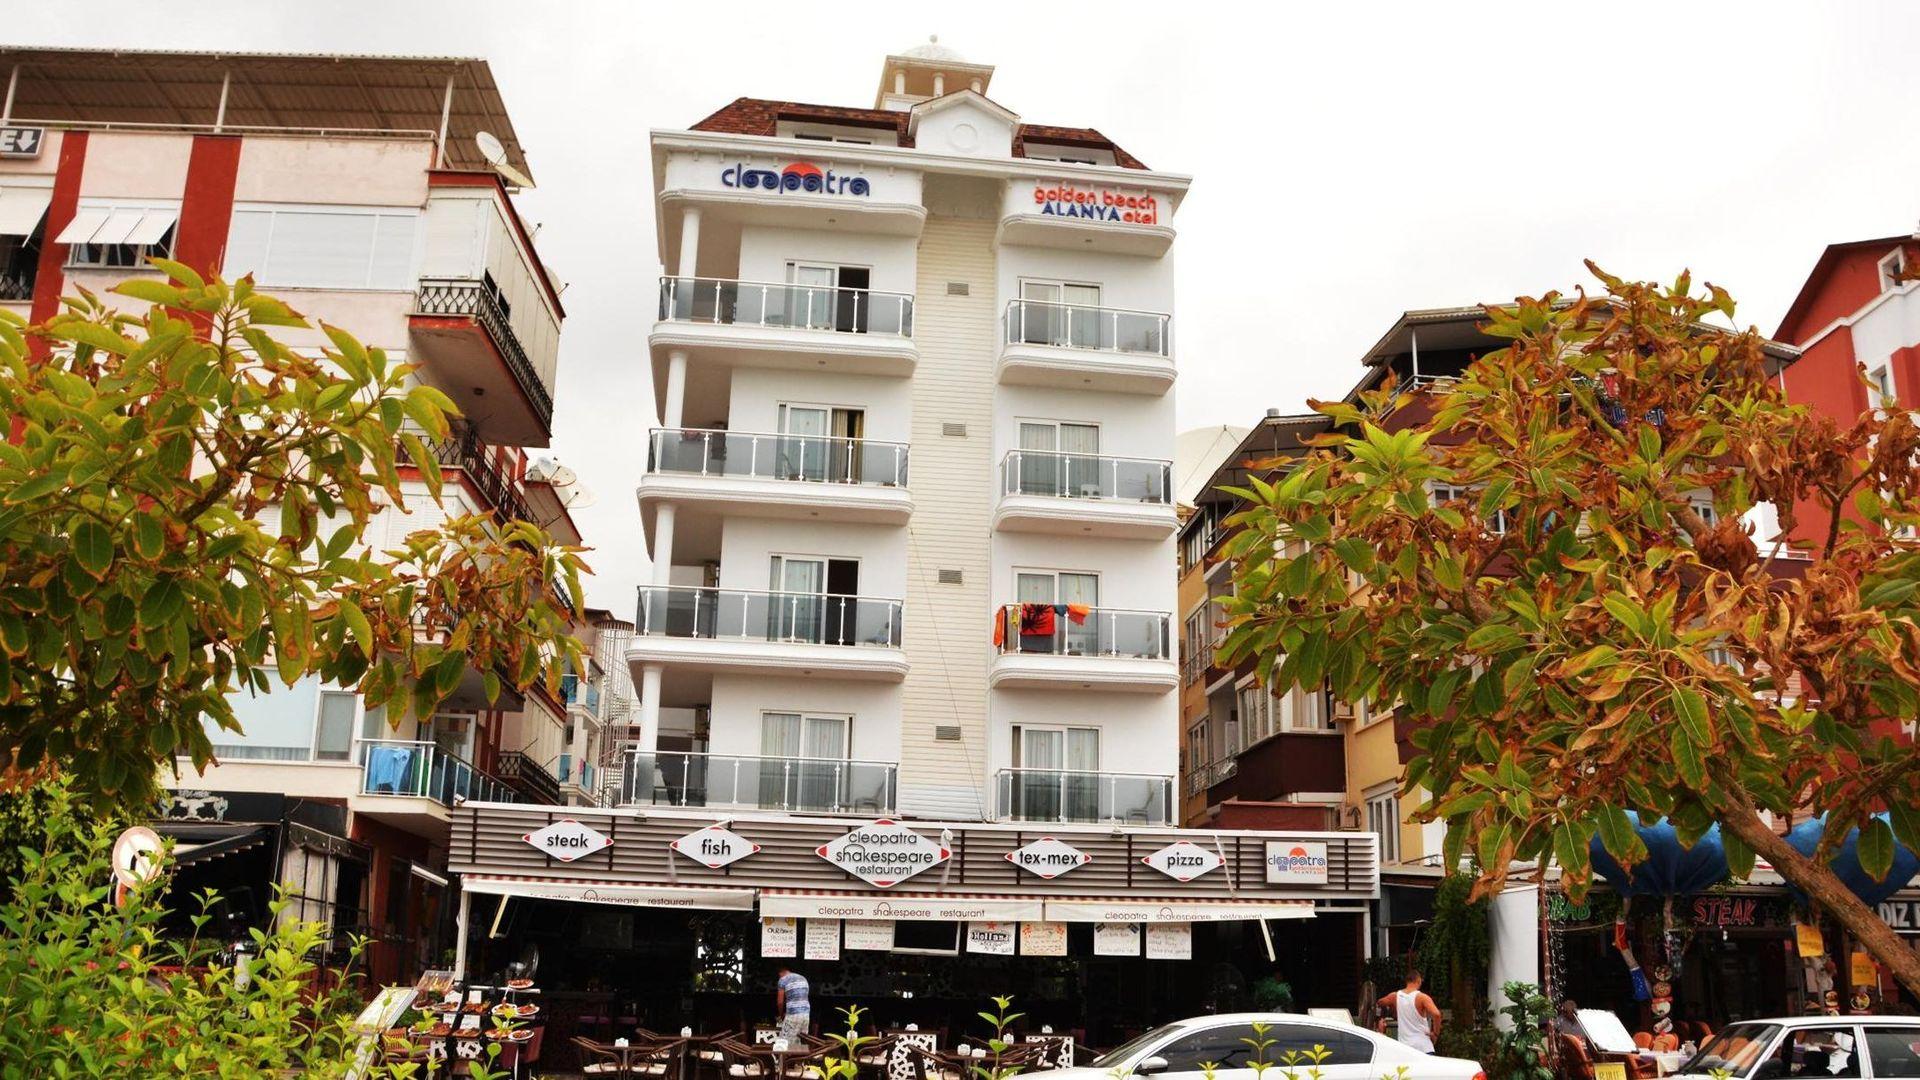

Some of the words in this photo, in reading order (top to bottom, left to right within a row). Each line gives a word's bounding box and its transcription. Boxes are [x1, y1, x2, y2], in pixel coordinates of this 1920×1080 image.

[721, 162, 870, 197] cleopatra
[1035, 186, 1097, 204] golden
[1102, 190, 1157, 210] beach
[1041, 201, 1121, 222] ALANYA
[1122, 208, 1157, 225] otel
[546, 833, 589, 848] steak
[701, 838, 731, 855] fish
[848, 831, 918, 845] cleopatra
[835, 844, 934, 865] shakespeare
[1019, 851, 1079, 866] tex-mex
[1166, 851, 1204, 870] pizza
[854, 864, 913, 876] restaurant
[818, 906, 864, 918] cleopatra
[872, 902, 931, 918] shakespeare
[939, 908, 985, 918] restaurant
[1104, 911, 1148, 921] cleopatra
[1694, 896, 1757, 925] STEAK
